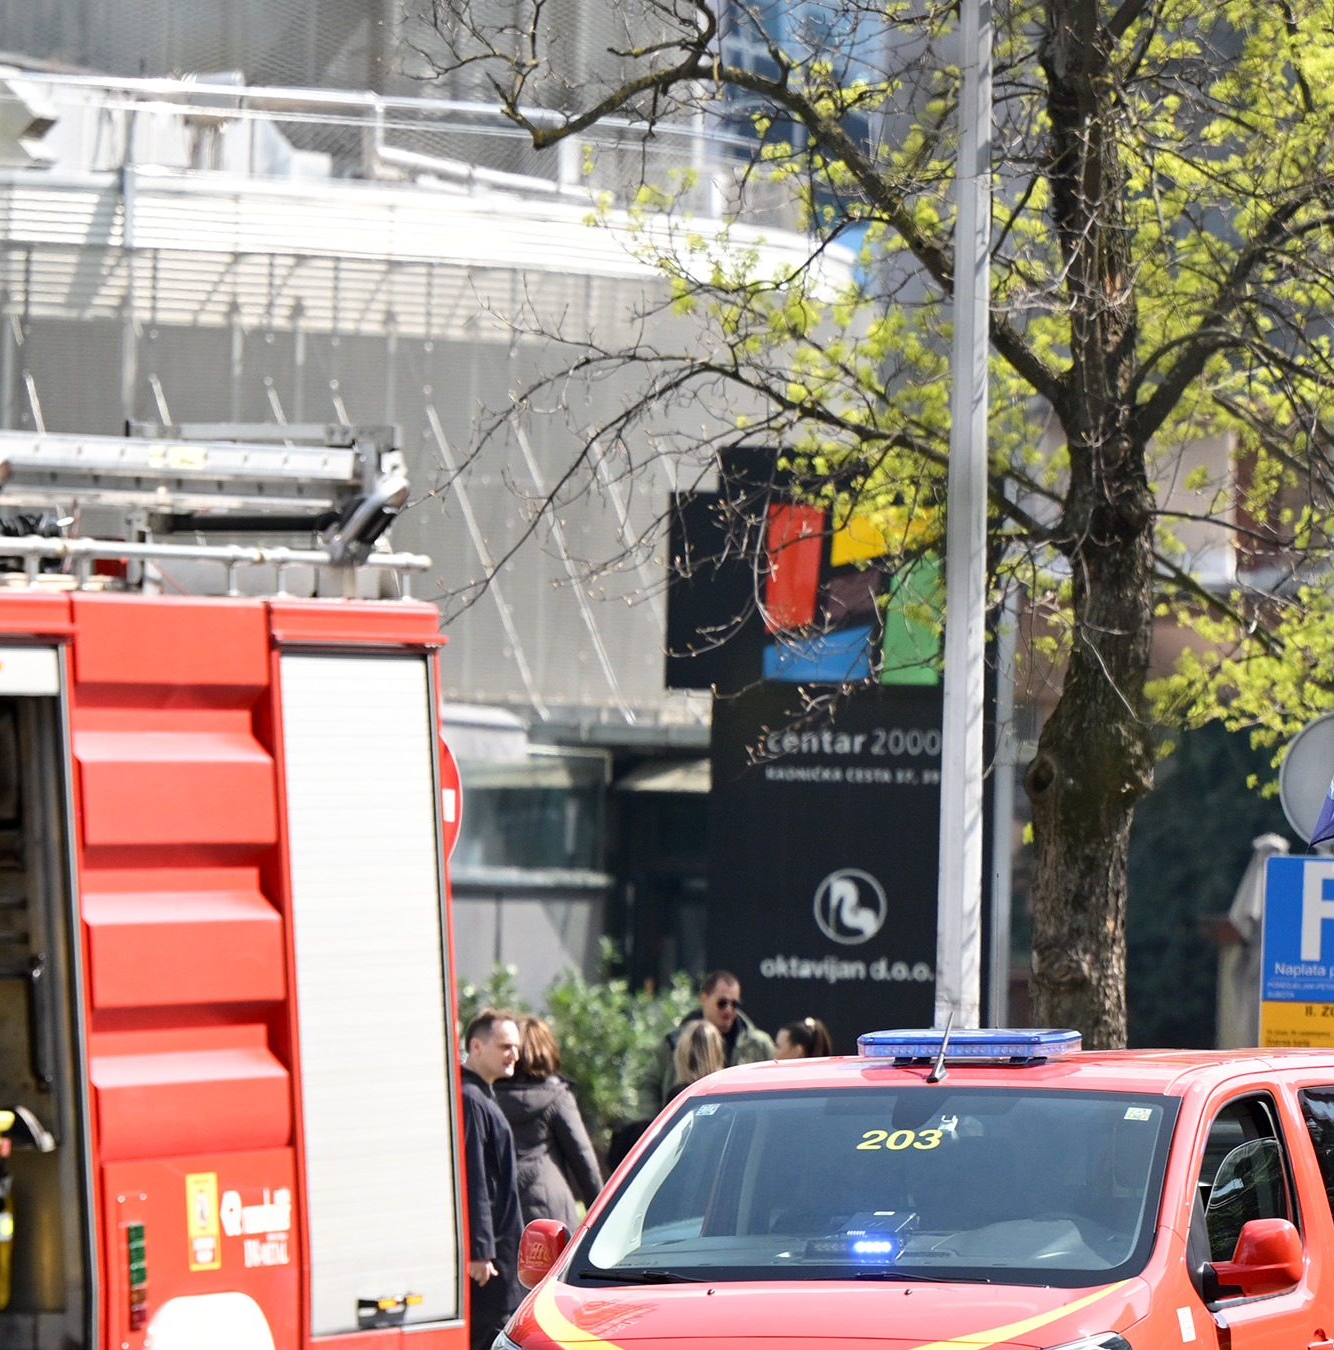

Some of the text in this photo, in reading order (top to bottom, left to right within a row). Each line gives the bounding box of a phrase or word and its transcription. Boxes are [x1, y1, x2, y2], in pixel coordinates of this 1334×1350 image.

[767, 726, 942, 756] centar 2000
[759, 953, 935, 985] oktavijan d.o.o.
[1274, 962, 1327, 980] Naplata
[856, 1119, 944, 1151] 203
